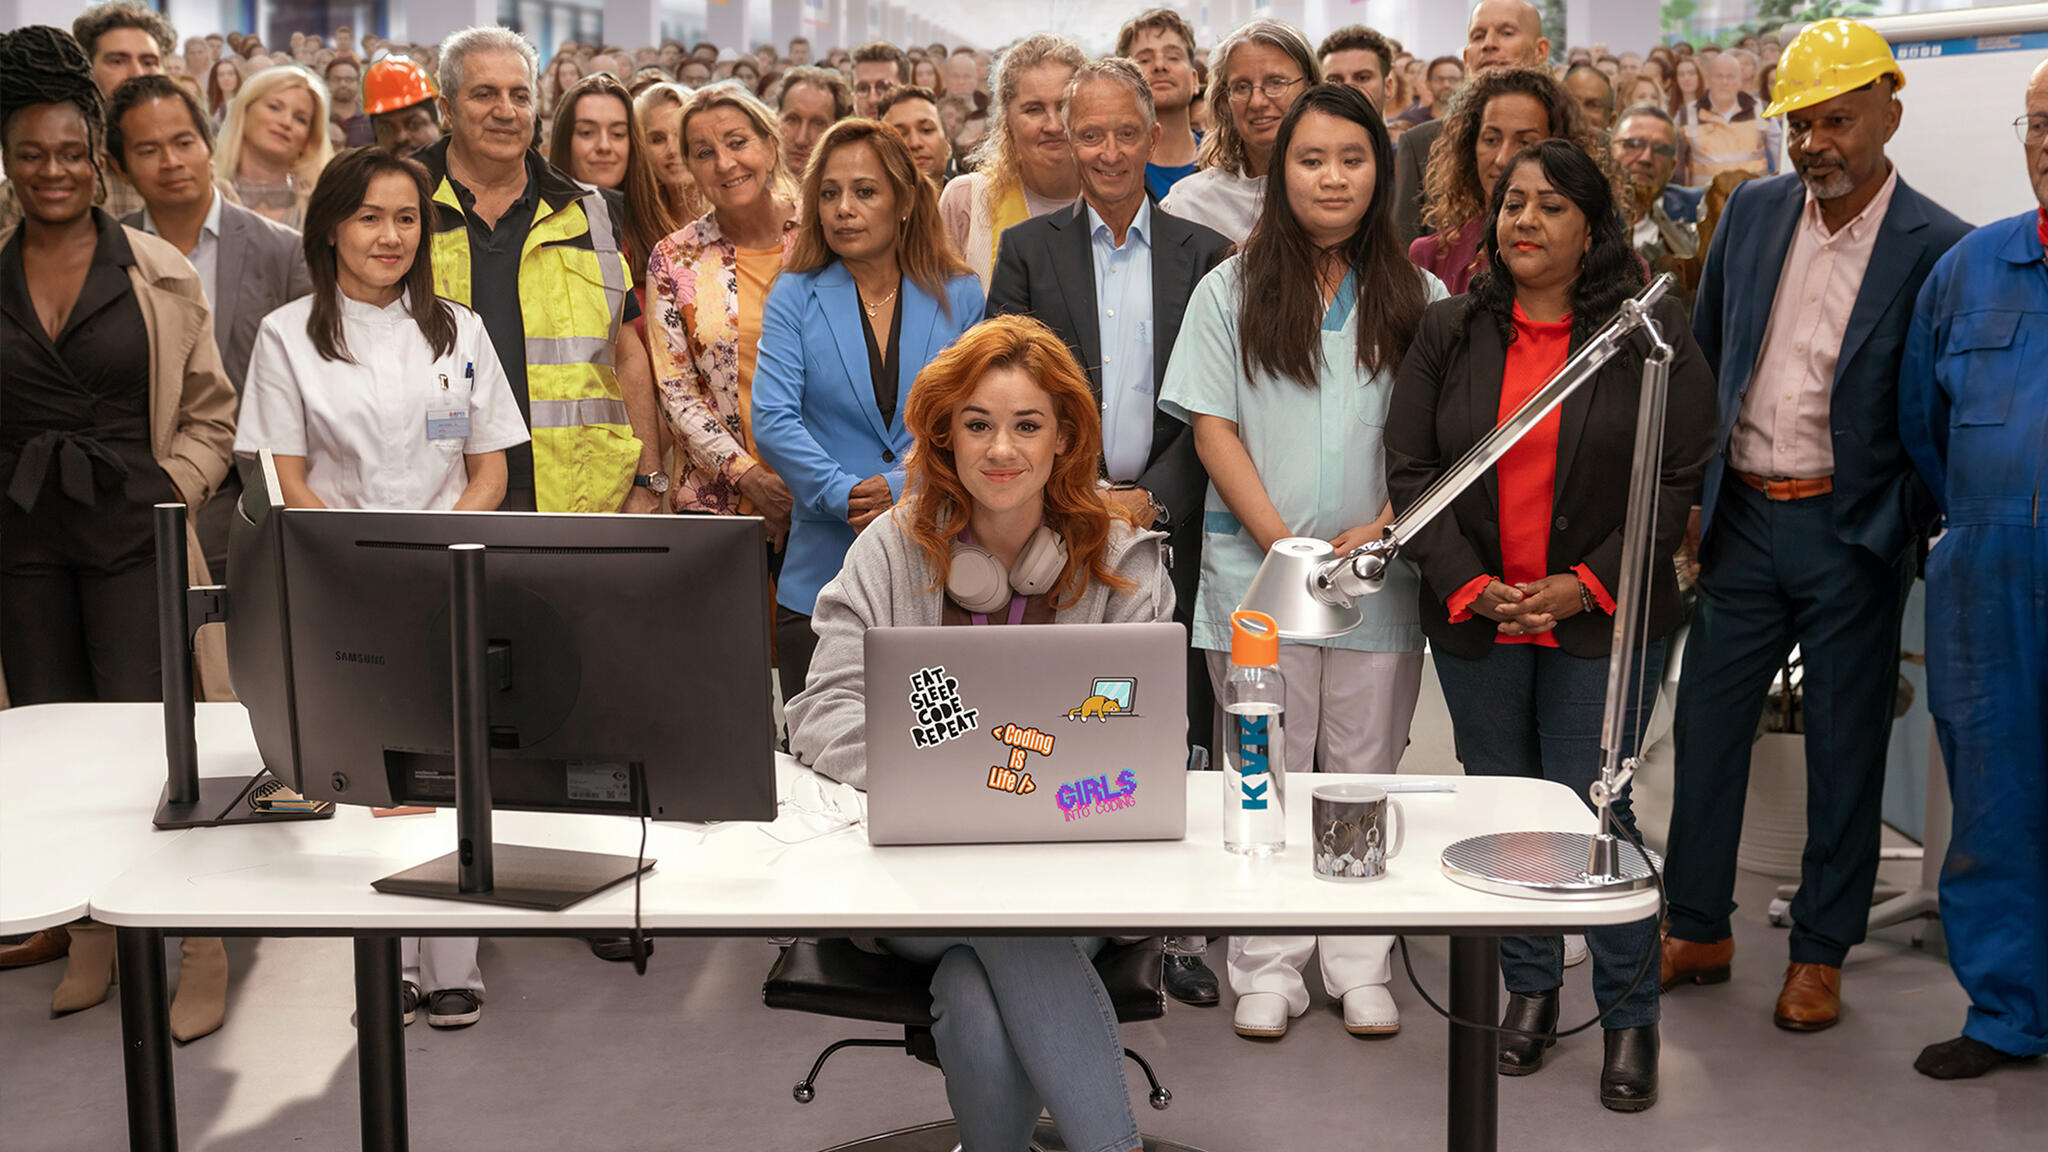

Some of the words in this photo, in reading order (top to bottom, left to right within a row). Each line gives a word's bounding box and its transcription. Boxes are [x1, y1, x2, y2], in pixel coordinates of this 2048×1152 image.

[335, 650, 385, 665] SAMSUNG
[911, 667, 944, 692] EAT
[911, 678, 957, 710] SLEEP
[918, 696, 962, 725] CODE
[911, 710, 977, 747] REPEAT
[1240, 714, 1269, 810] KVK
[1056, 768, 1138, 811] GIRLS
[1064, 805, 1091, 822] INTO
[1096, 794, 1136, 815] CODING
